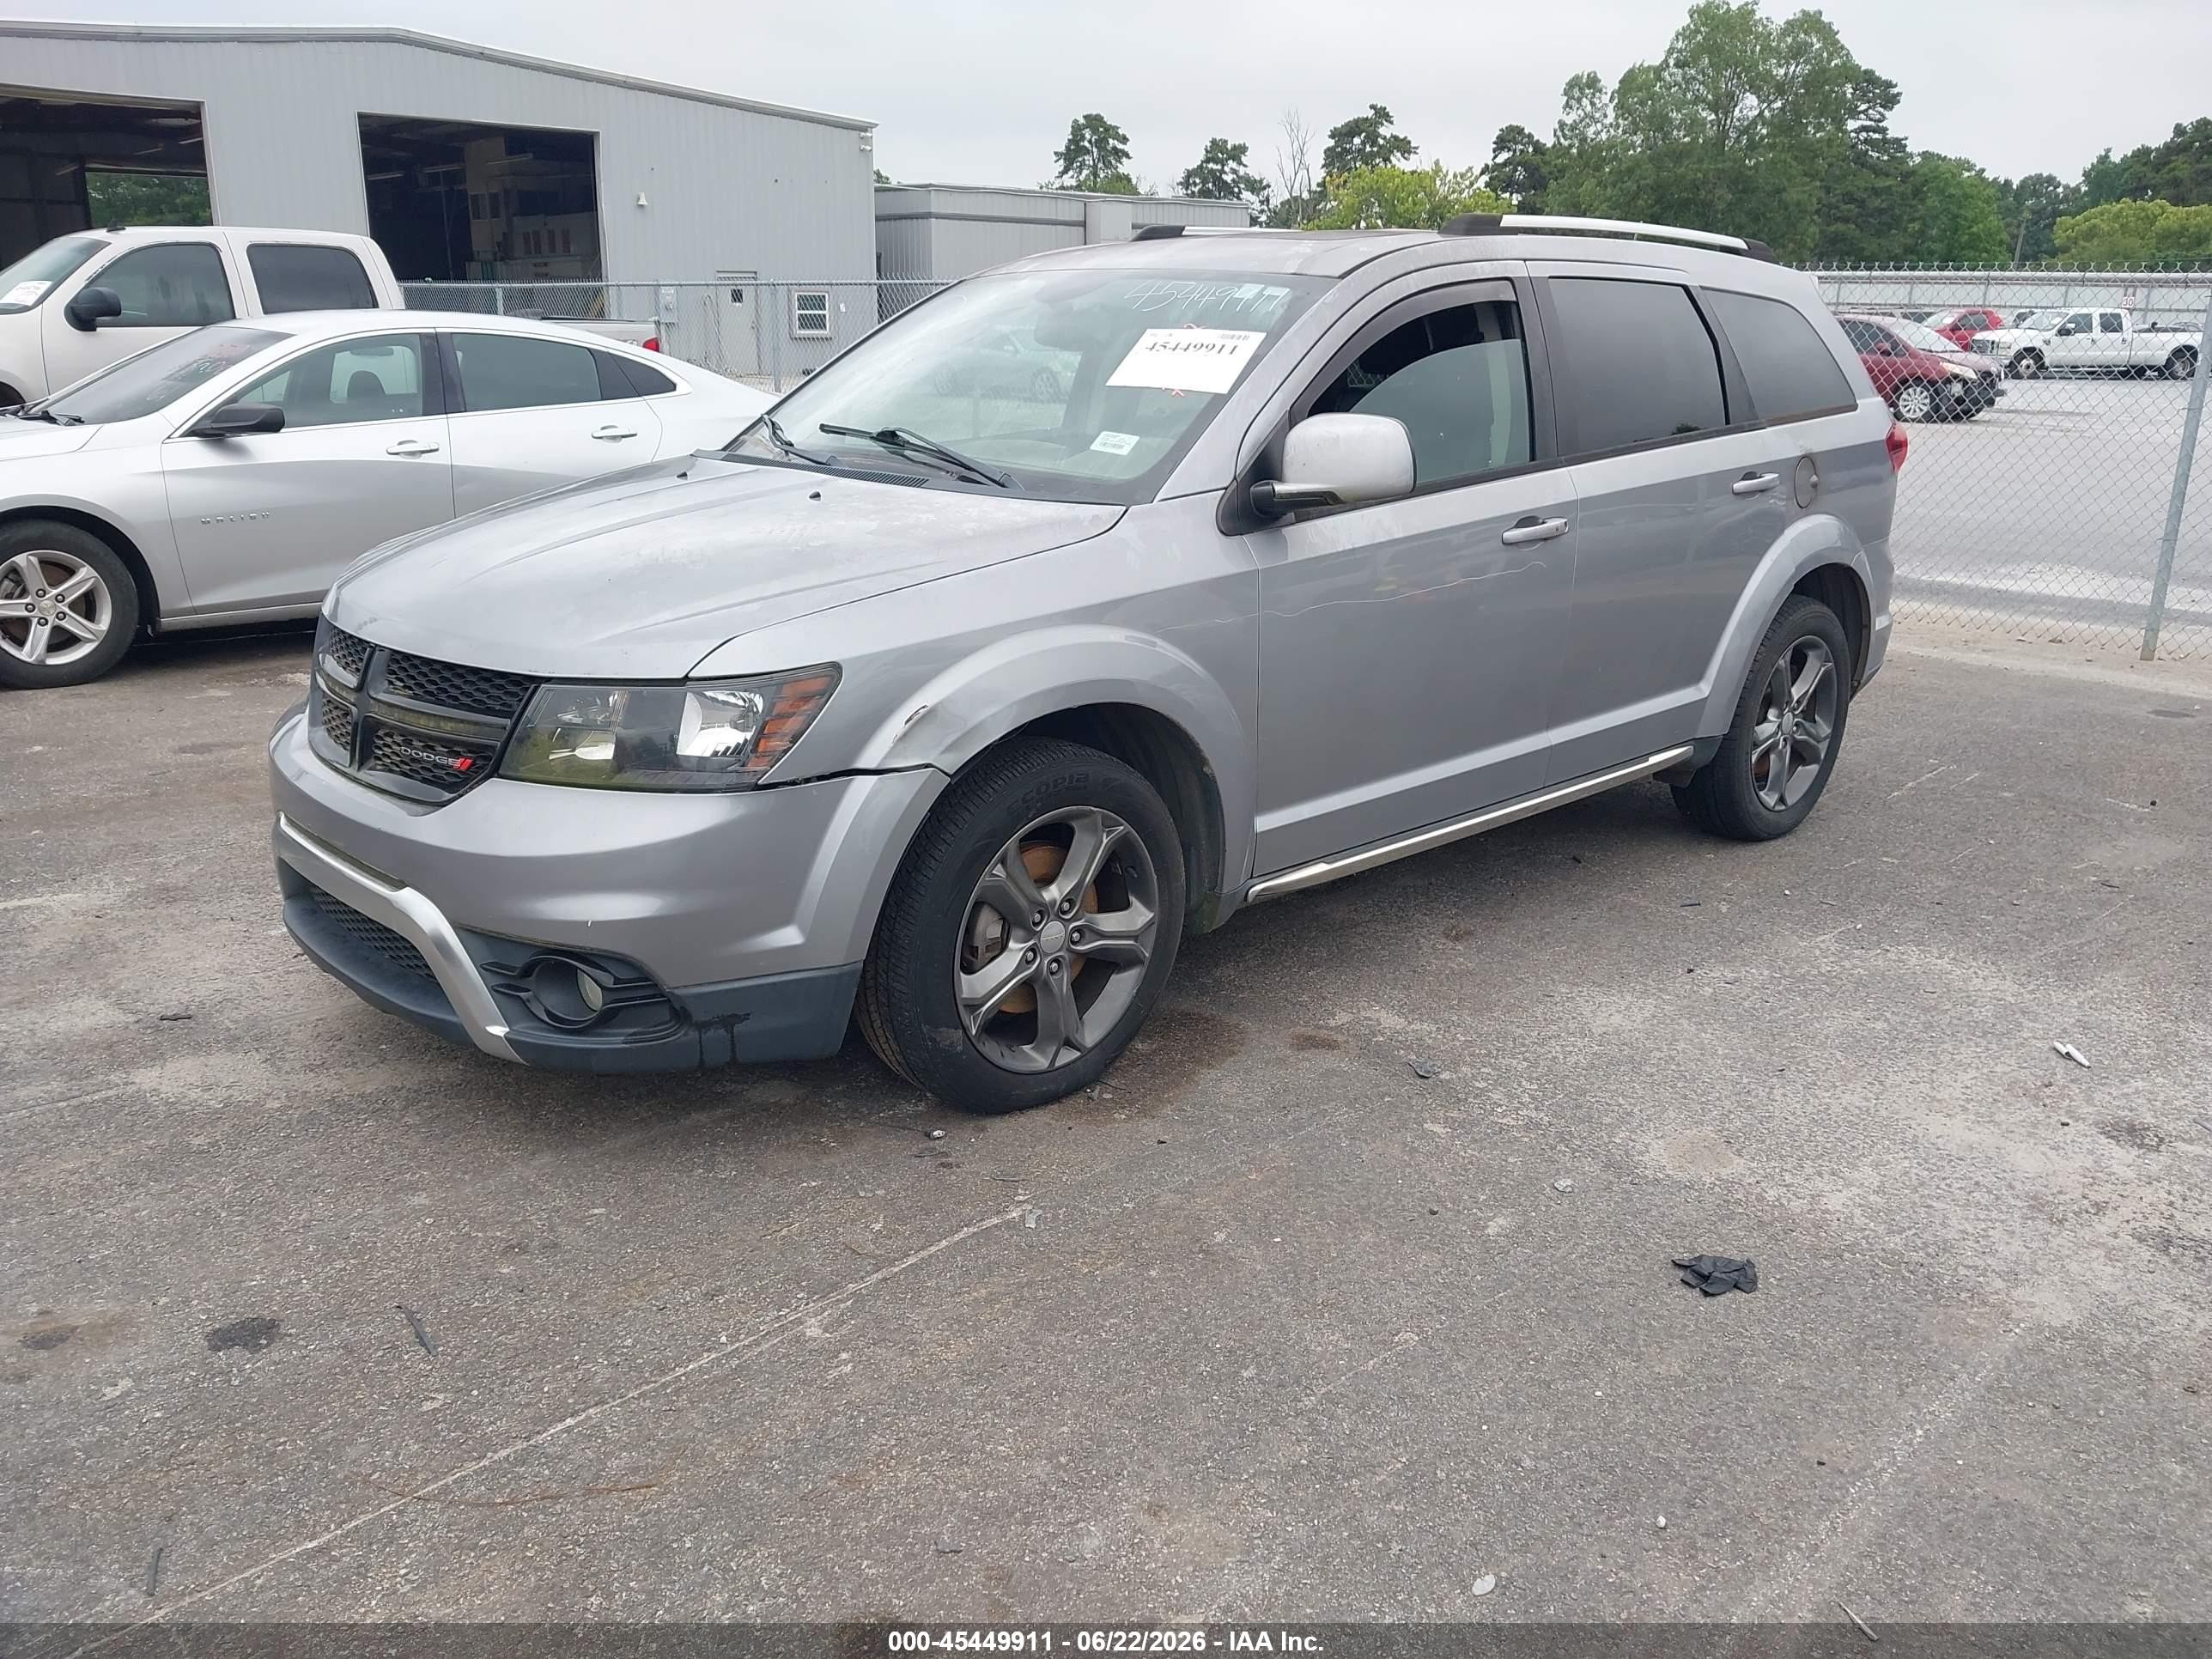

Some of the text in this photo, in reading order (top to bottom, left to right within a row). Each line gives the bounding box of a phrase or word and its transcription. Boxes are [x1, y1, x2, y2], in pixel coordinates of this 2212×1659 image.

[1146, 341, 1239, 356] 45449911
[200, 511, 270, 525] MALIBU
[400, 746, 462, 767] DODGE
